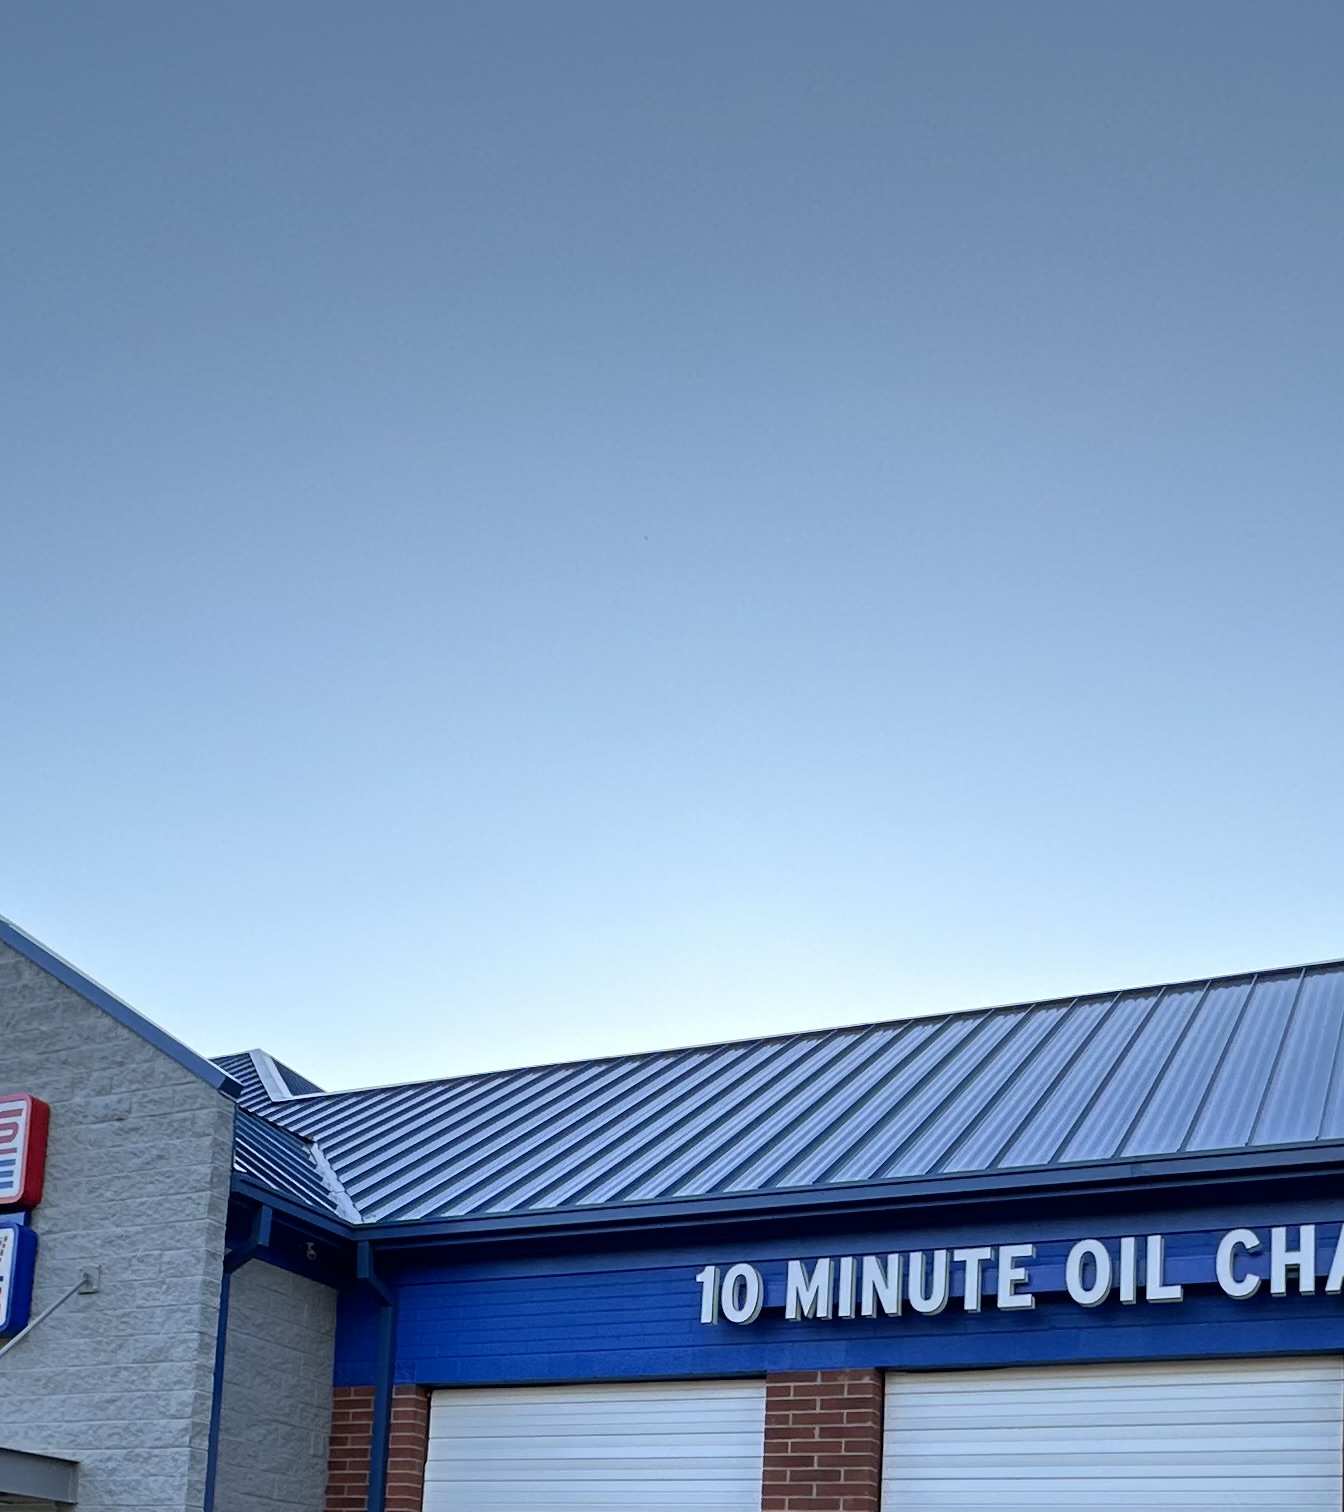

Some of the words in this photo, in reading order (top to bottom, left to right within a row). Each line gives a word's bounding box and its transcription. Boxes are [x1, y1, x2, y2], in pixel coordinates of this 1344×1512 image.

[696, 1262, 763, 1325] 10
[785, 1243, 1036, 1321] MINUTE
[1065, 1234, 1184, 1308] OIL
